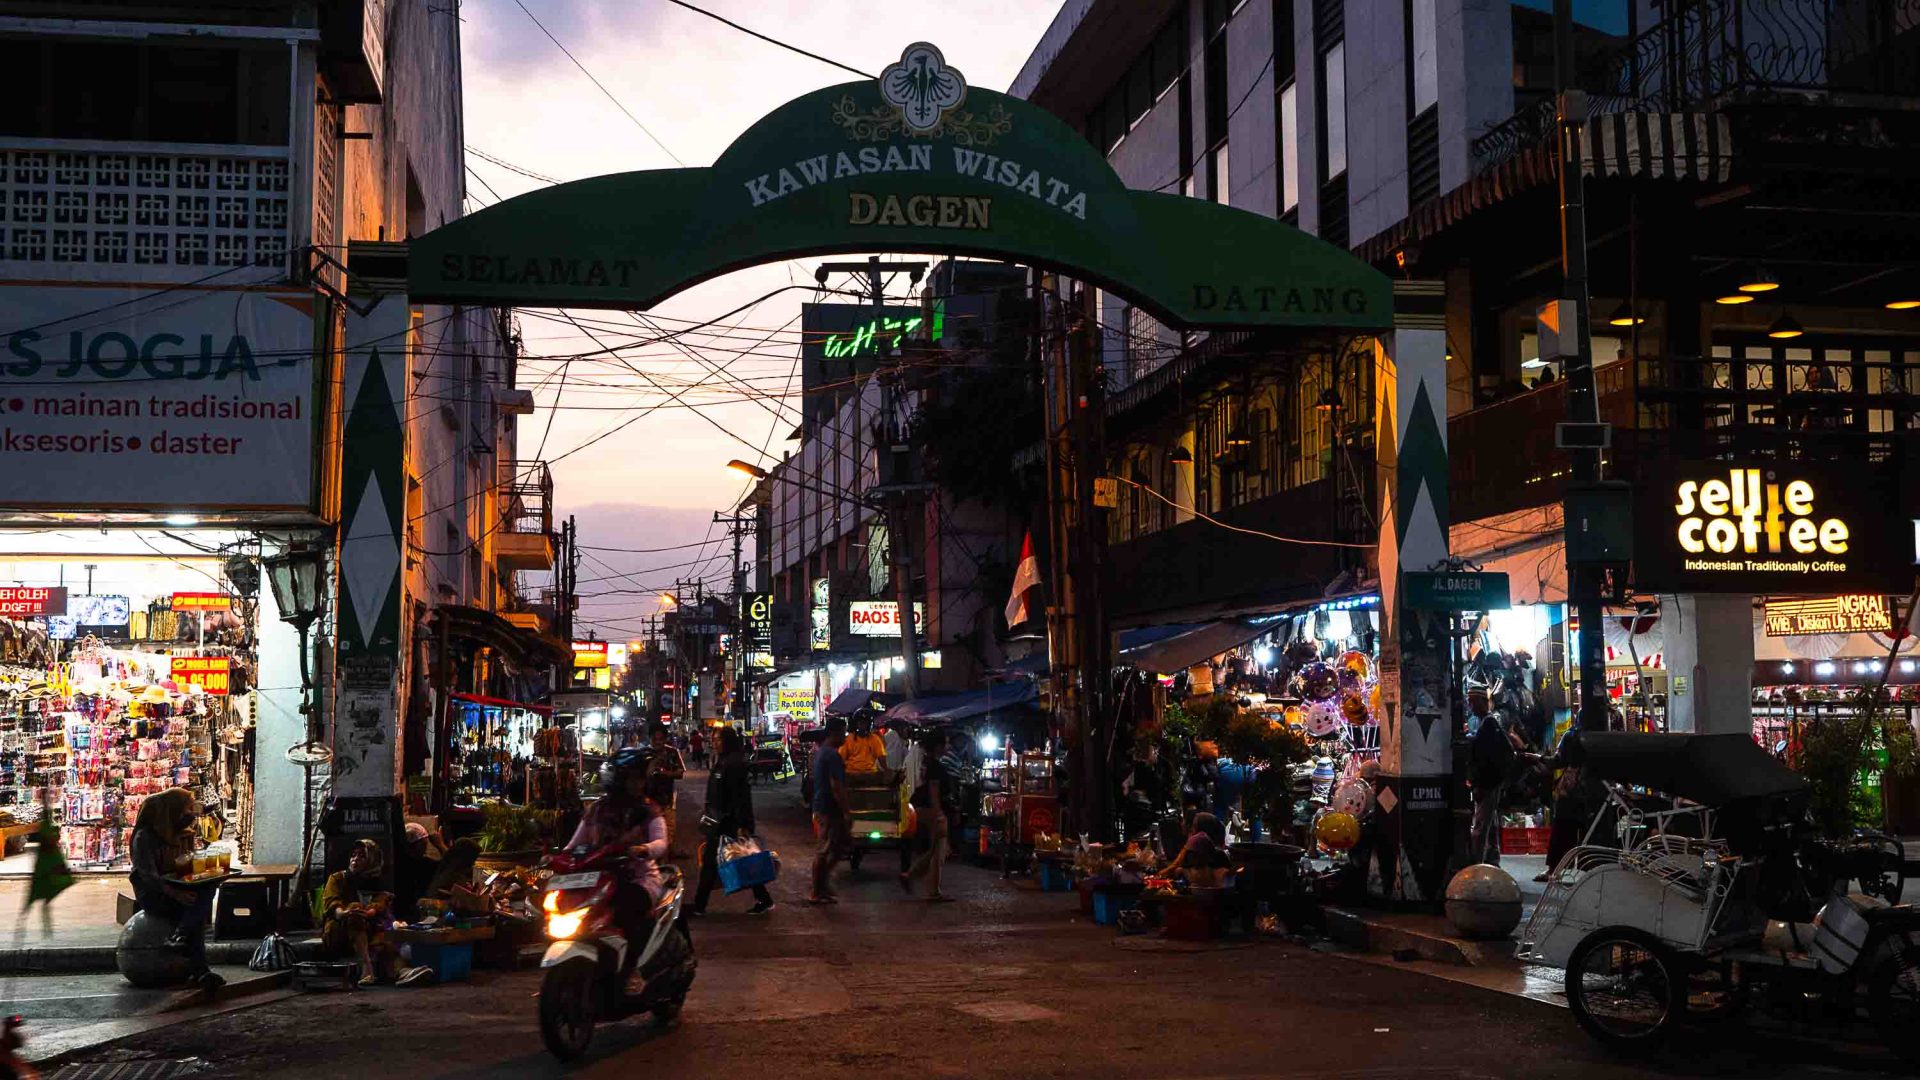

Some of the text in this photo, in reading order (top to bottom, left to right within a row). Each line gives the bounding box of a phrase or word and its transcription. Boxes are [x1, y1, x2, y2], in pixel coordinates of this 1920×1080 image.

[744, 145, 1087, 220] KAWASAN WISATA
[849, 193, 991, 229] DAGEN
[440, 253, 1368, 314] SELAMAT DATANG
[56, 331, 261, 381] JOGJA
[33, 391, 141, 418] mainan
[148, 394, 300, 420] tradisional
[0, 428, 243, 456] ksesoris daster
[1685, 559, 1847, 575] Indonesian Traditionally Coffee
[0, 589, 48, 600] EH OLEH
[852, 611, 889, 624] RAOS
